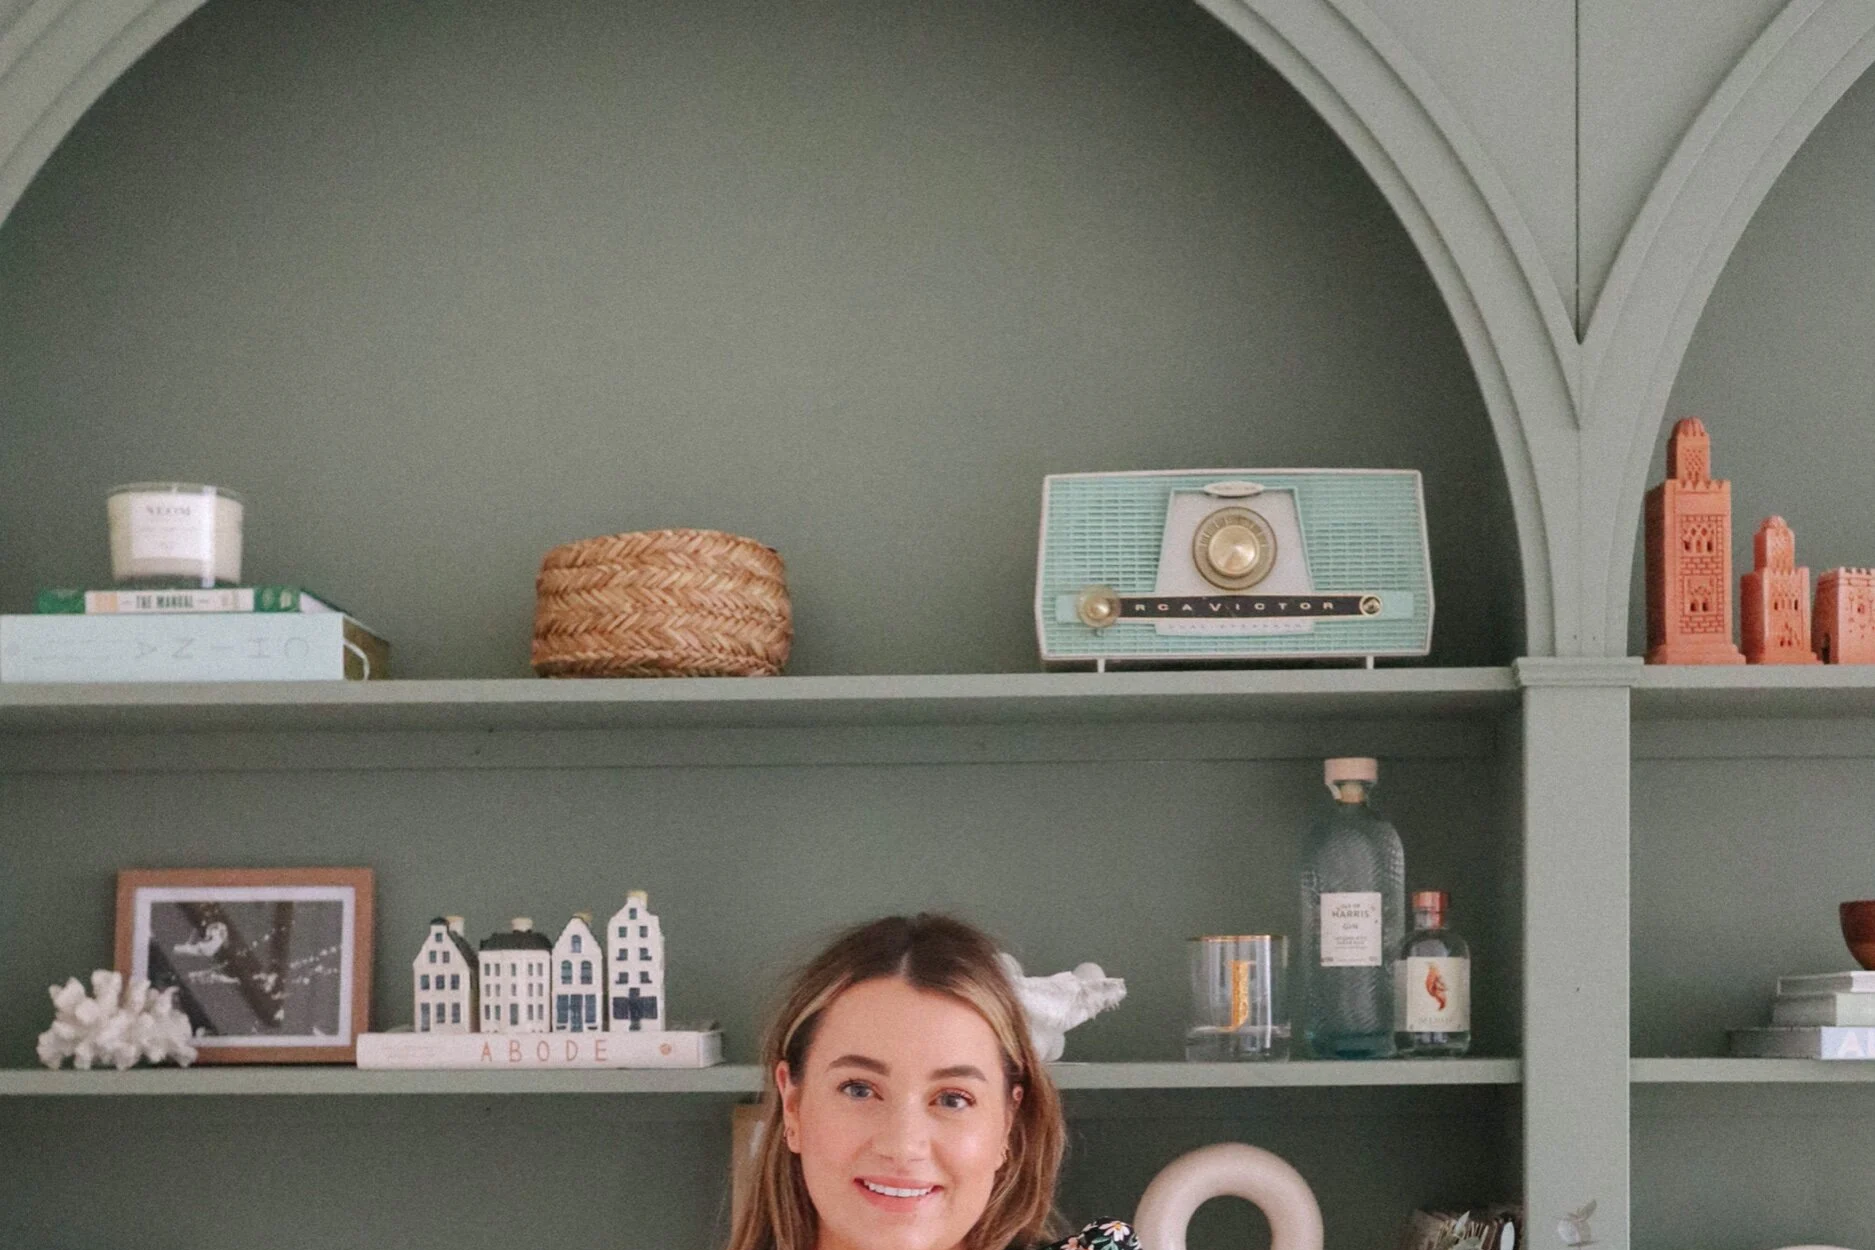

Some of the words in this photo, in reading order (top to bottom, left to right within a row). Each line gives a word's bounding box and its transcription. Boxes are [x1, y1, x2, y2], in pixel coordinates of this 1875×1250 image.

[1135, 603, 1193, 612] RCA
[1209, 602, 1334, 611] VICTOR
[1332, 910, 1369, 918] HARRIS
[480, 1040, 608, 1062] ABODE
